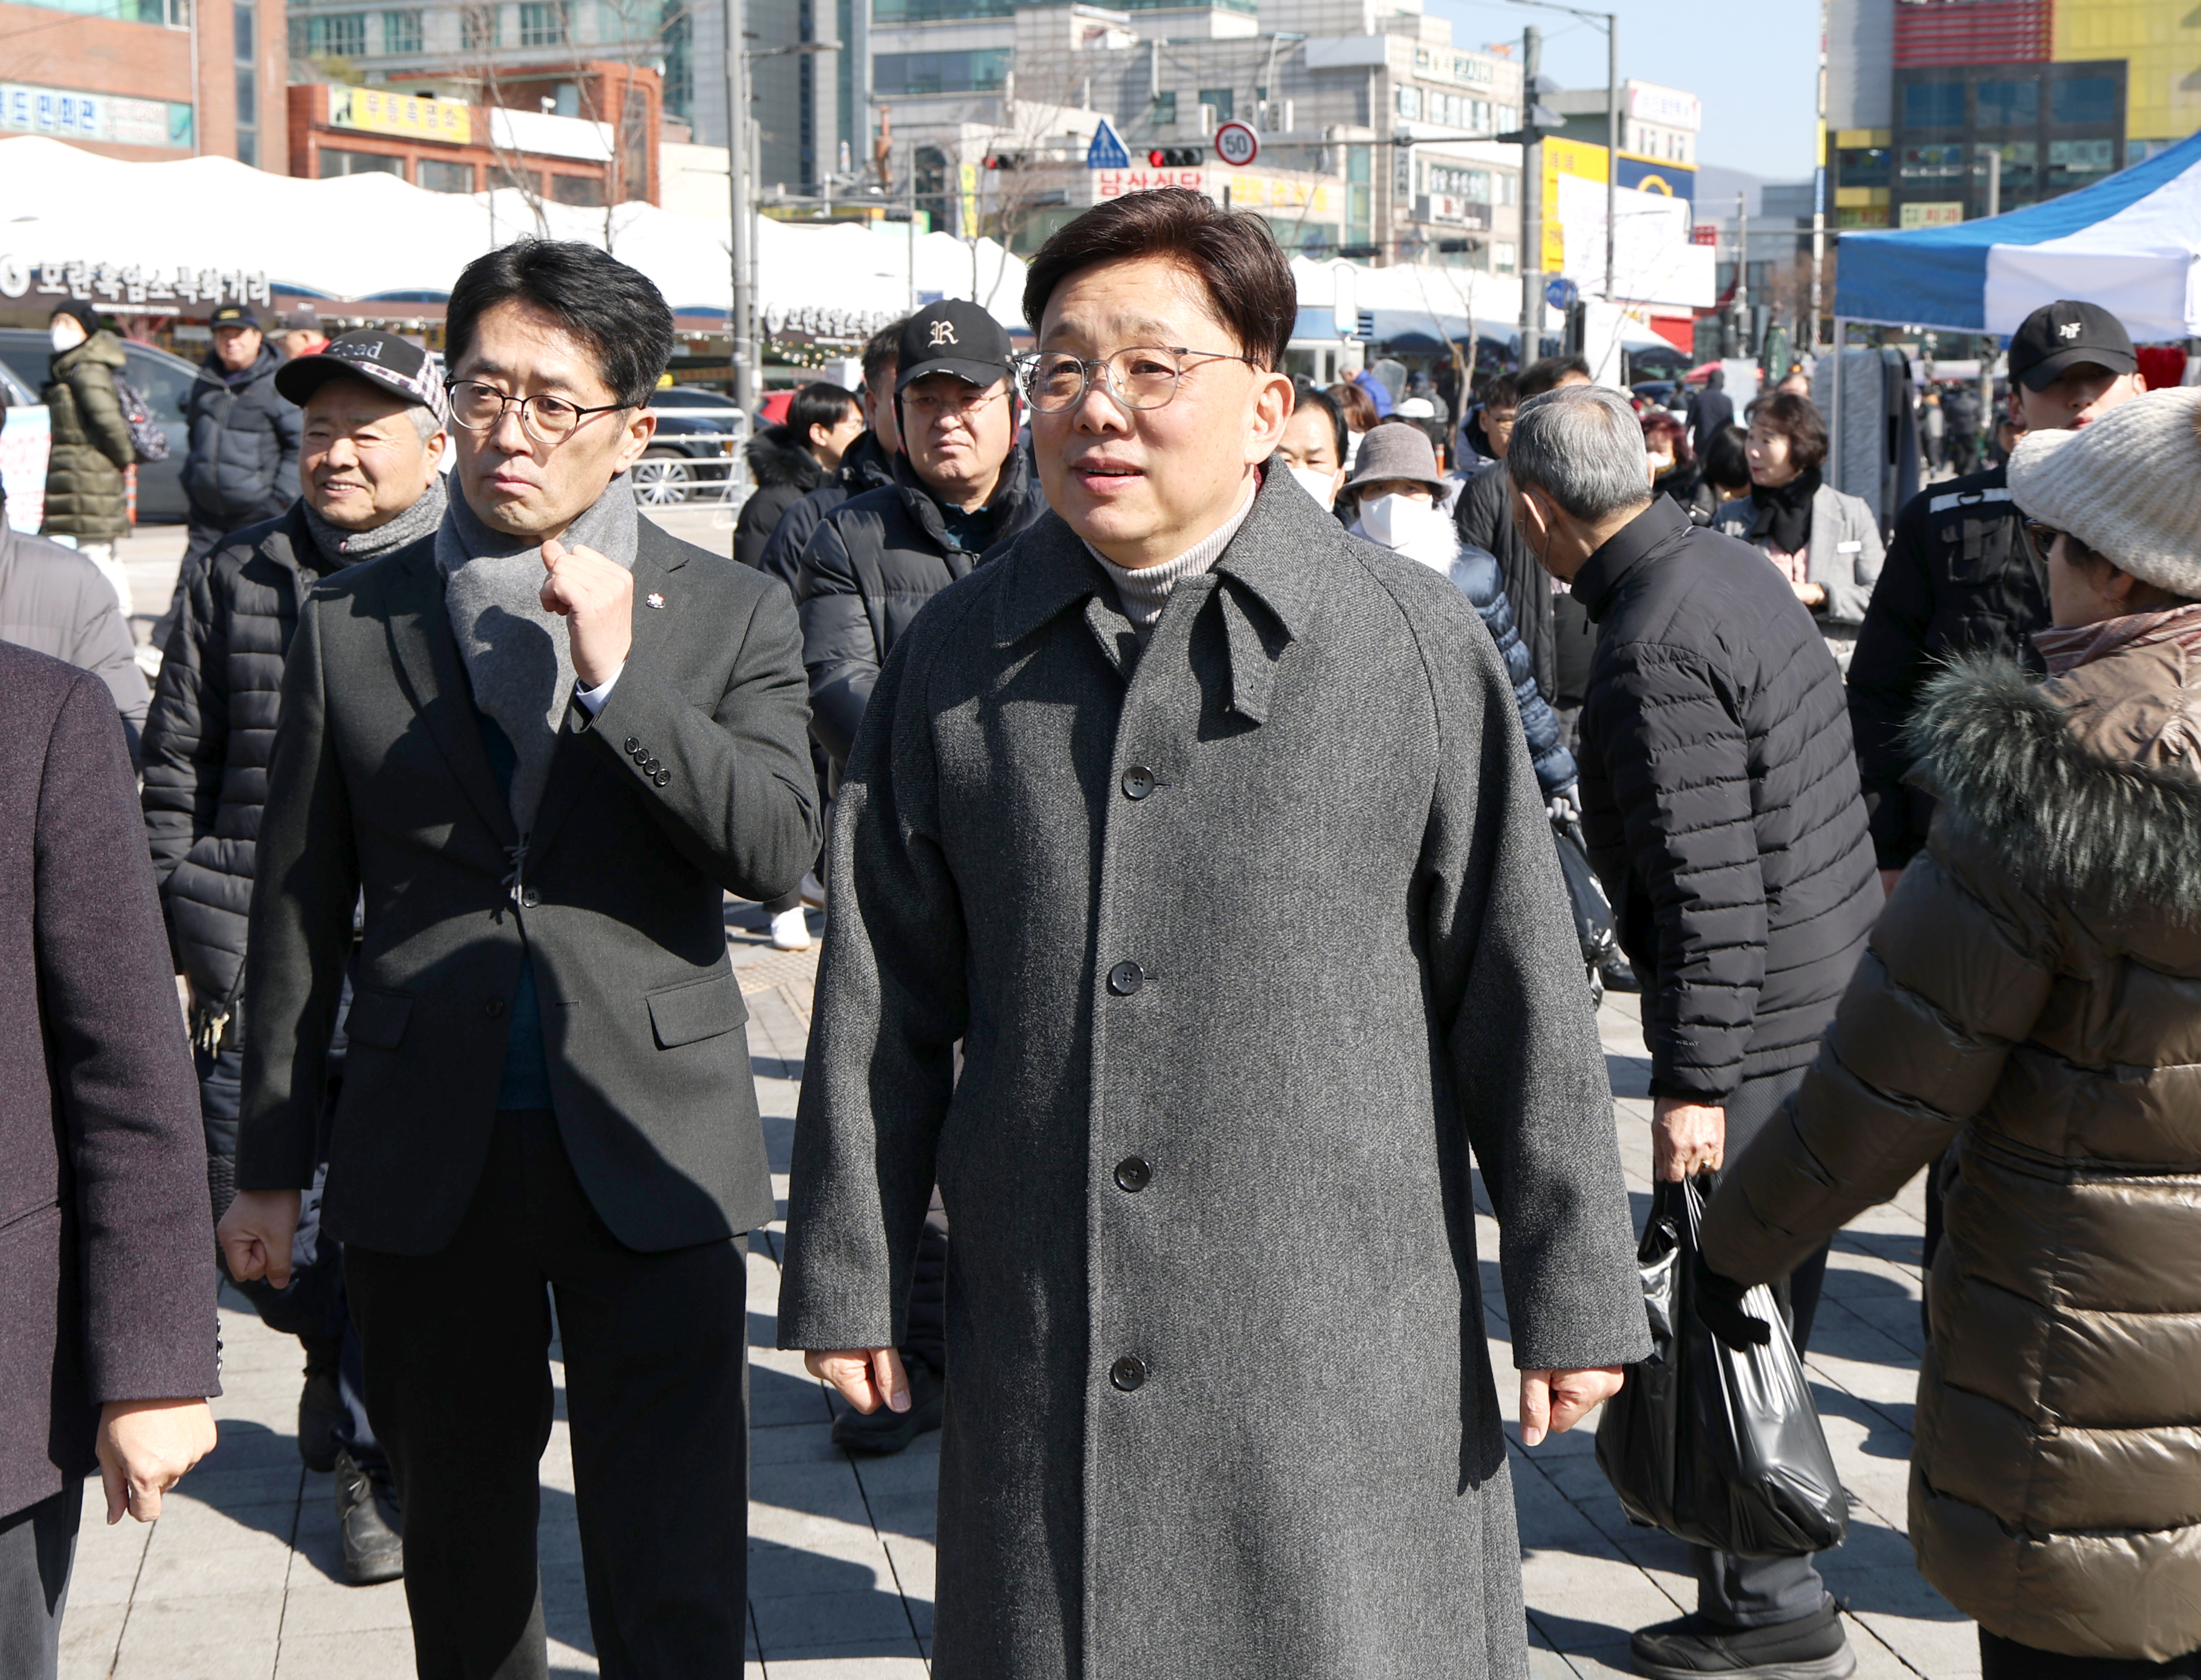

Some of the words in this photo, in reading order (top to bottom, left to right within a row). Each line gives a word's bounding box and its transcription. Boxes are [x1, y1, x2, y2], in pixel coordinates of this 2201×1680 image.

[0, 91, 94, 129] 도민회관
[1224, 134, 1248, 154] 50
[927, 320, 959, 348] R
